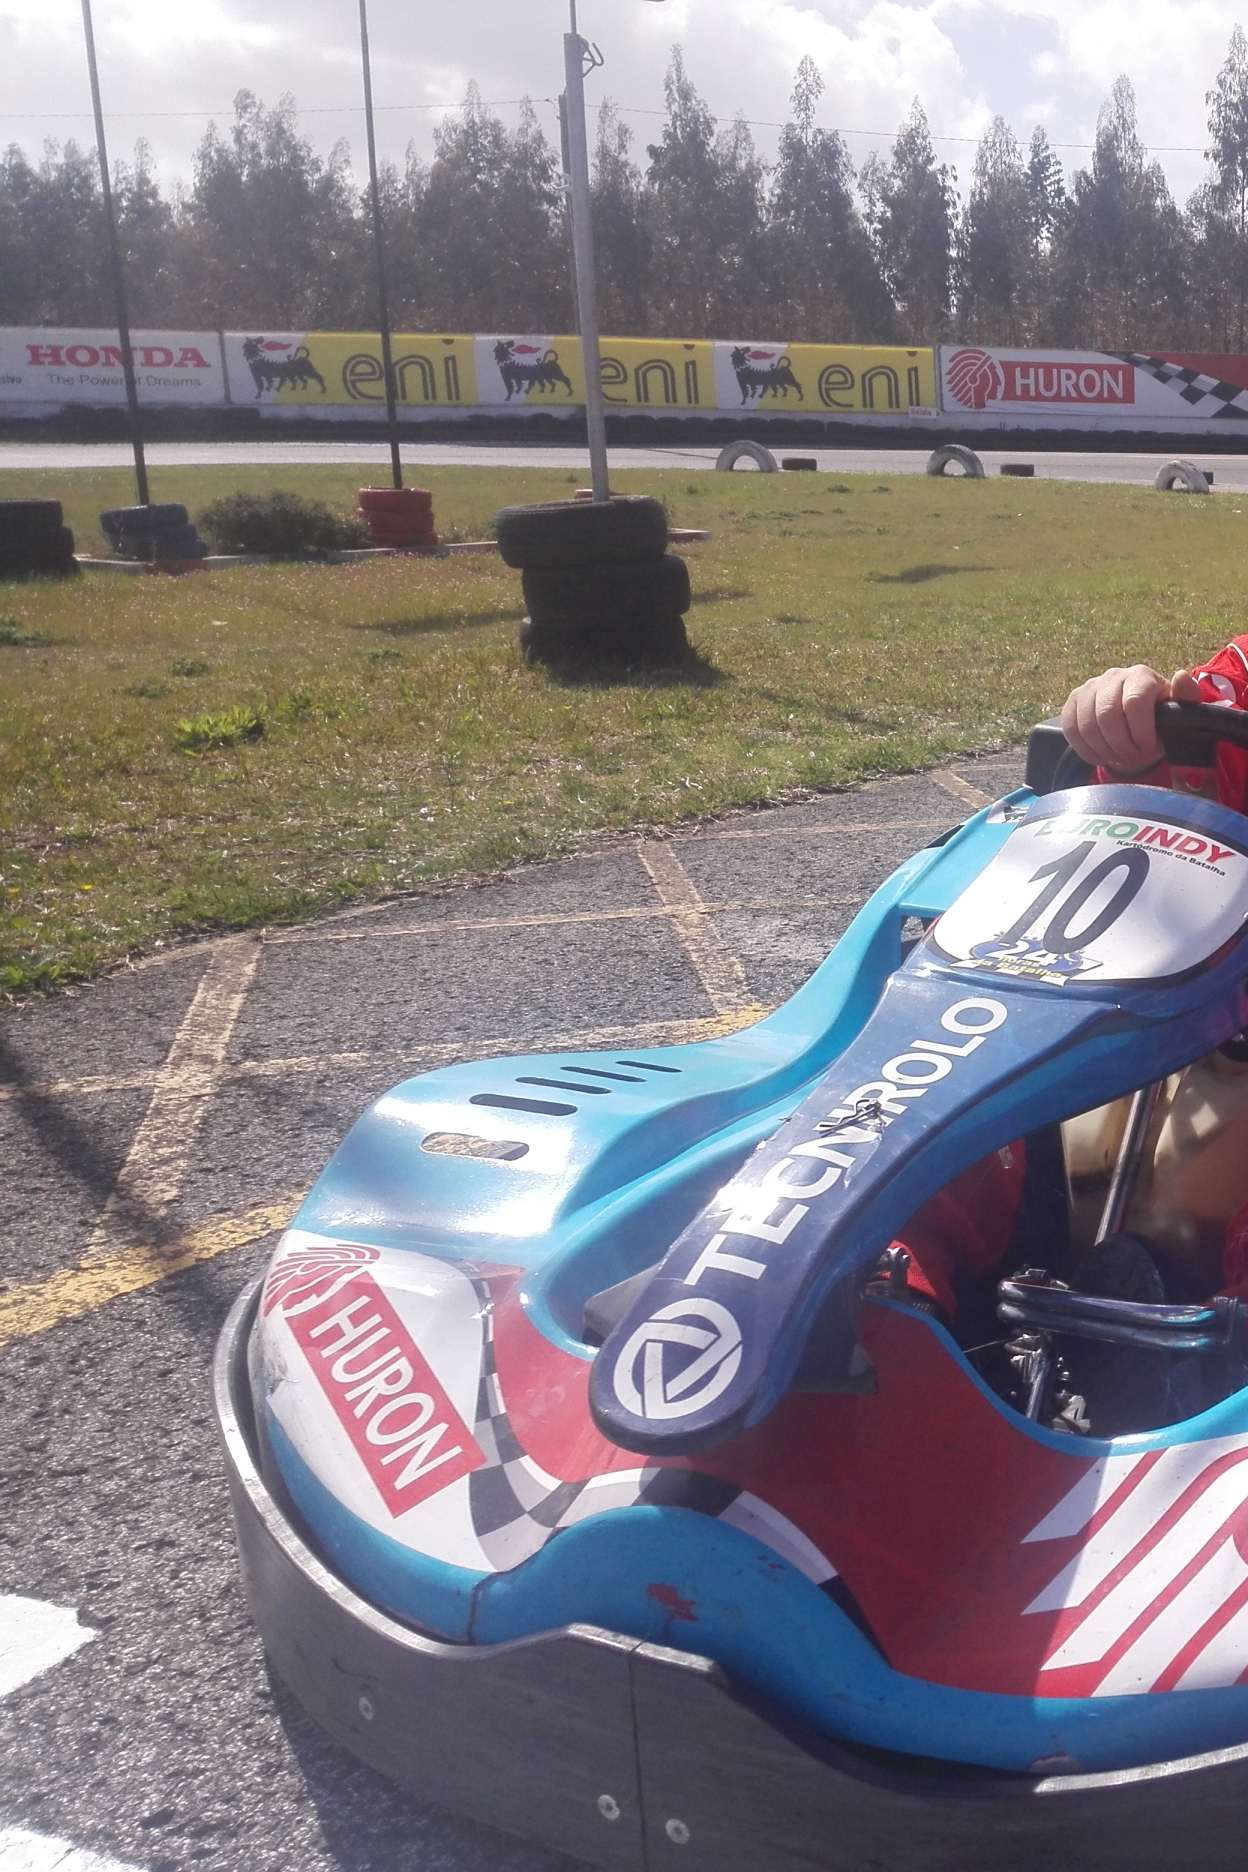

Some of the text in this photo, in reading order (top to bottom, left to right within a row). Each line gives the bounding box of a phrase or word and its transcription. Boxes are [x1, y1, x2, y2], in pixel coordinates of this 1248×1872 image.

[342, 338, 457, 401] eni
[600, 343, 699, 405] eni
[817, 350, 920, 408] eni
[1015, 367, 1125, 399] HURON
[1174, 852, 1188, 862] da
[1188, 856, 1226, 877] Batalha
[1003, 840, 1150, 955] 10
[683, 997, 1009, 1286] TECNIROLO
[309, 1294, 464, 1491] HURON
